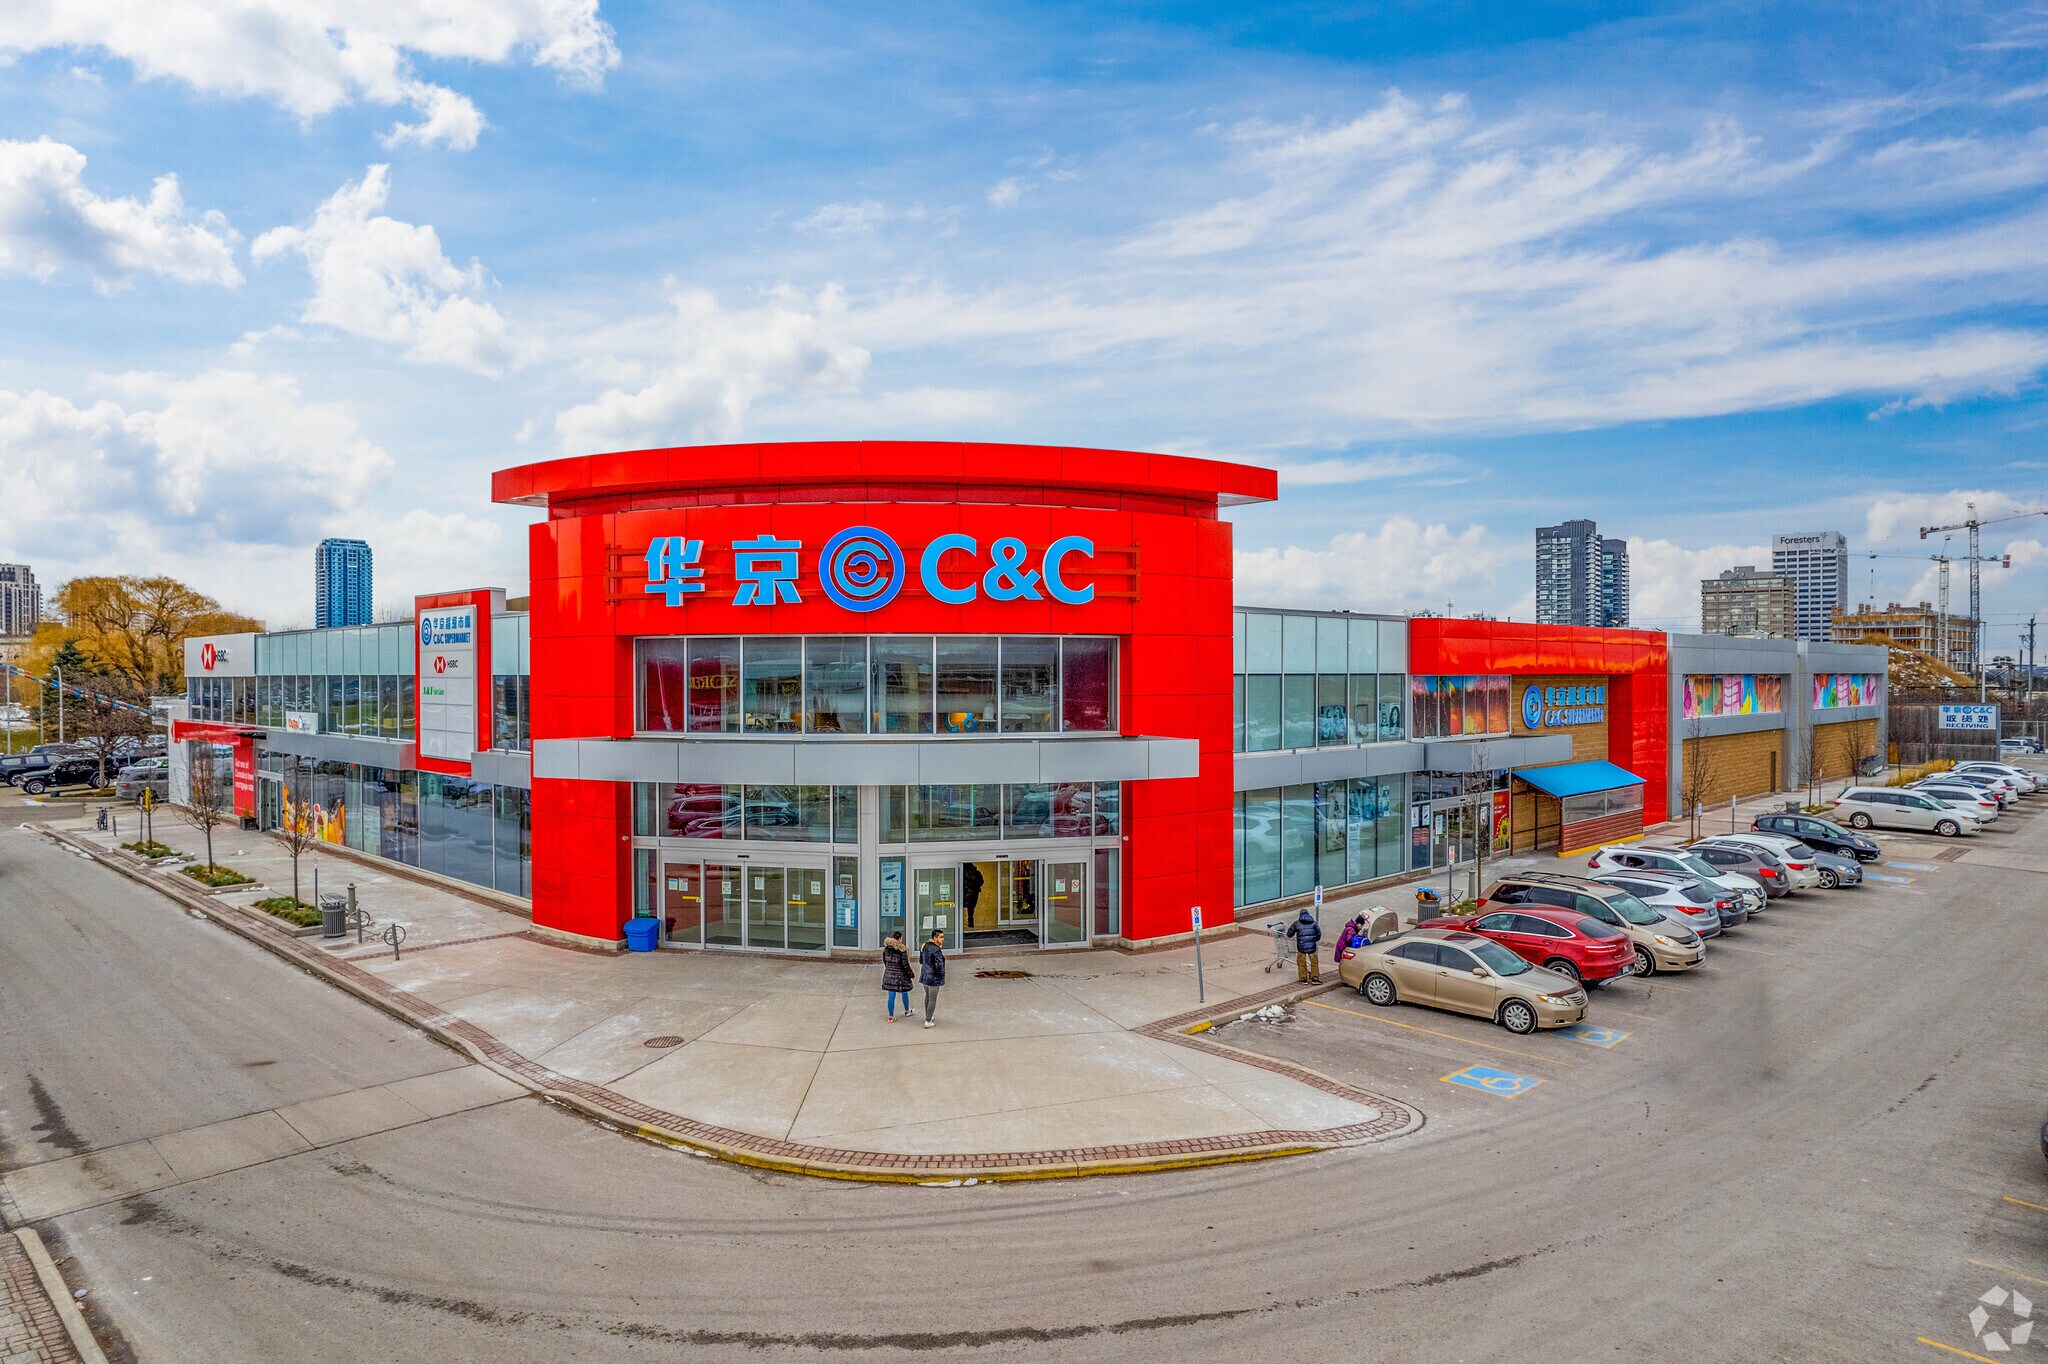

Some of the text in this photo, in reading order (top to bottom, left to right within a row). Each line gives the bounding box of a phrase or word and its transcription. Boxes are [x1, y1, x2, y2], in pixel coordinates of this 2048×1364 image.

[1780, 536, 1820, 544] Foresters
[920, 533, 1095, 605] C&C
[433, 632, 471, 645] C&C SUPERMARKET
[447, 659, 459, 668] HSBC
[1973, 706, 1993, 714] C&C
[1545, 707, 1604, 727] C&C SUPERMARKET
